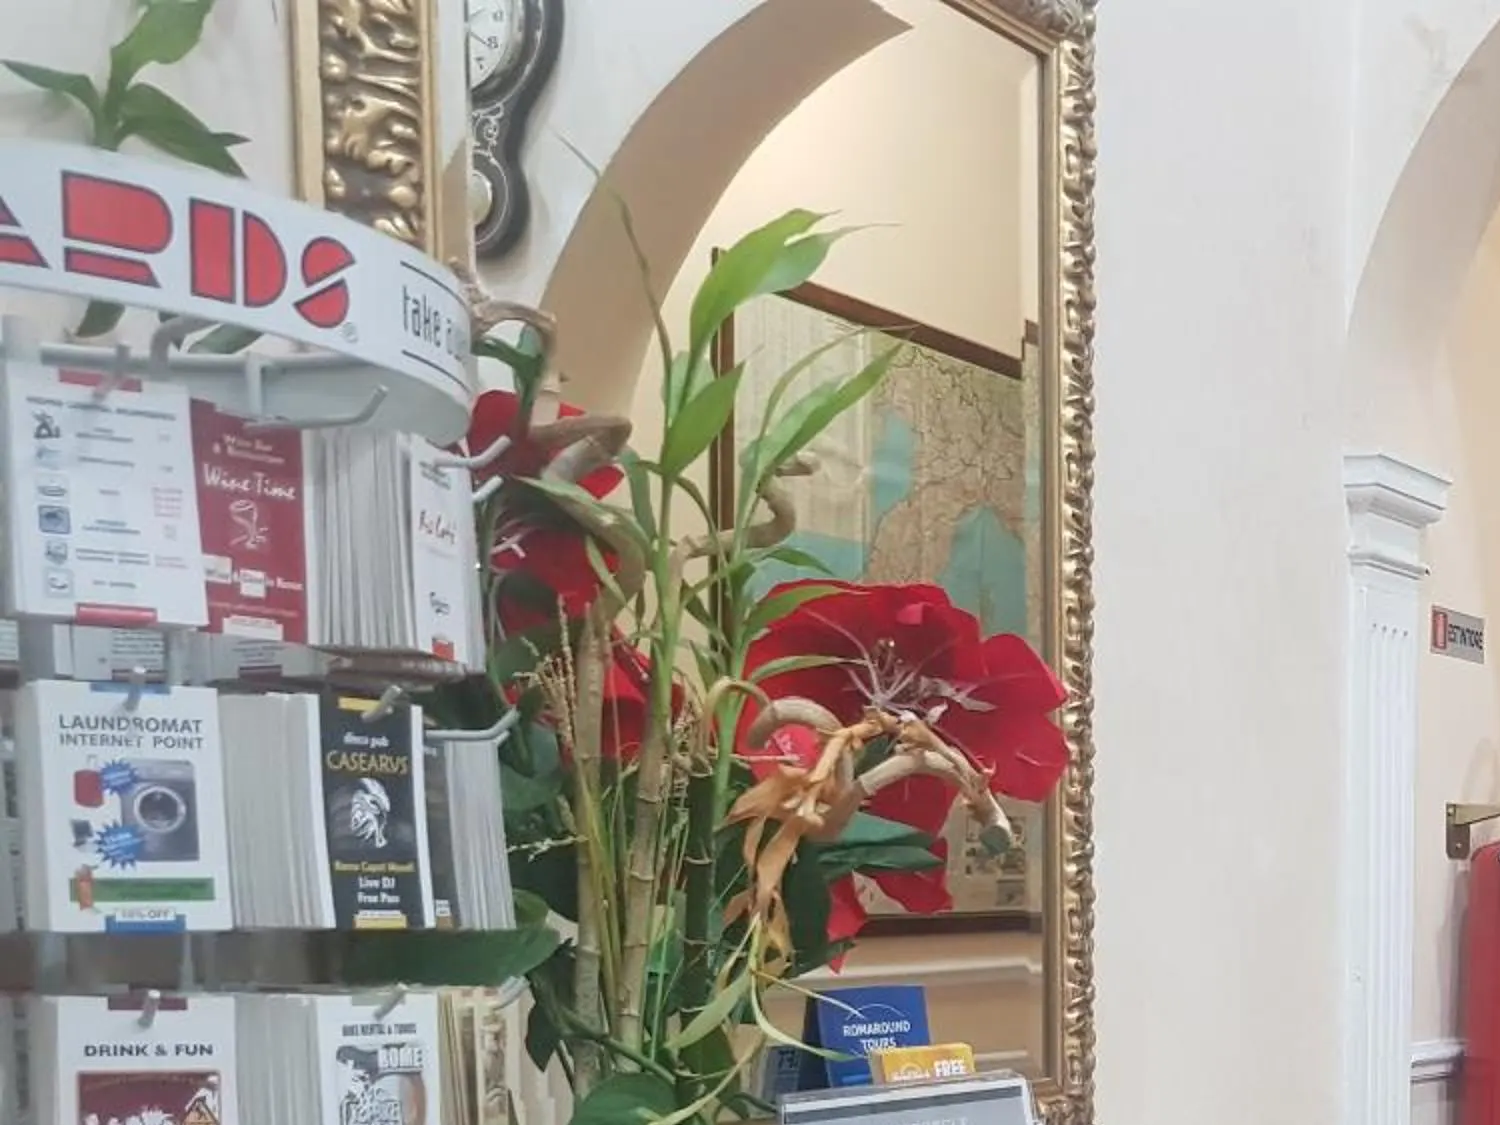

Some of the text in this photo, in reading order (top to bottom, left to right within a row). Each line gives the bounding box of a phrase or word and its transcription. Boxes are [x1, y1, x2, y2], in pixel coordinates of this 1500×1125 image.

[403, 284, 441, 348] take
[203, 463, 297, 500] Wine Time
[58, 713, 203, 735] LAUNDROMAT
[59, 733, 204, 750] INTERNET POINT
[843, 1019, 911, 1037] ROMAROUND
[83, 1043, 214, 1058] DRINK & FUN
[860, 1037, 897, 1051] TOURS
[933, 1058, 967, 1077] FREE
